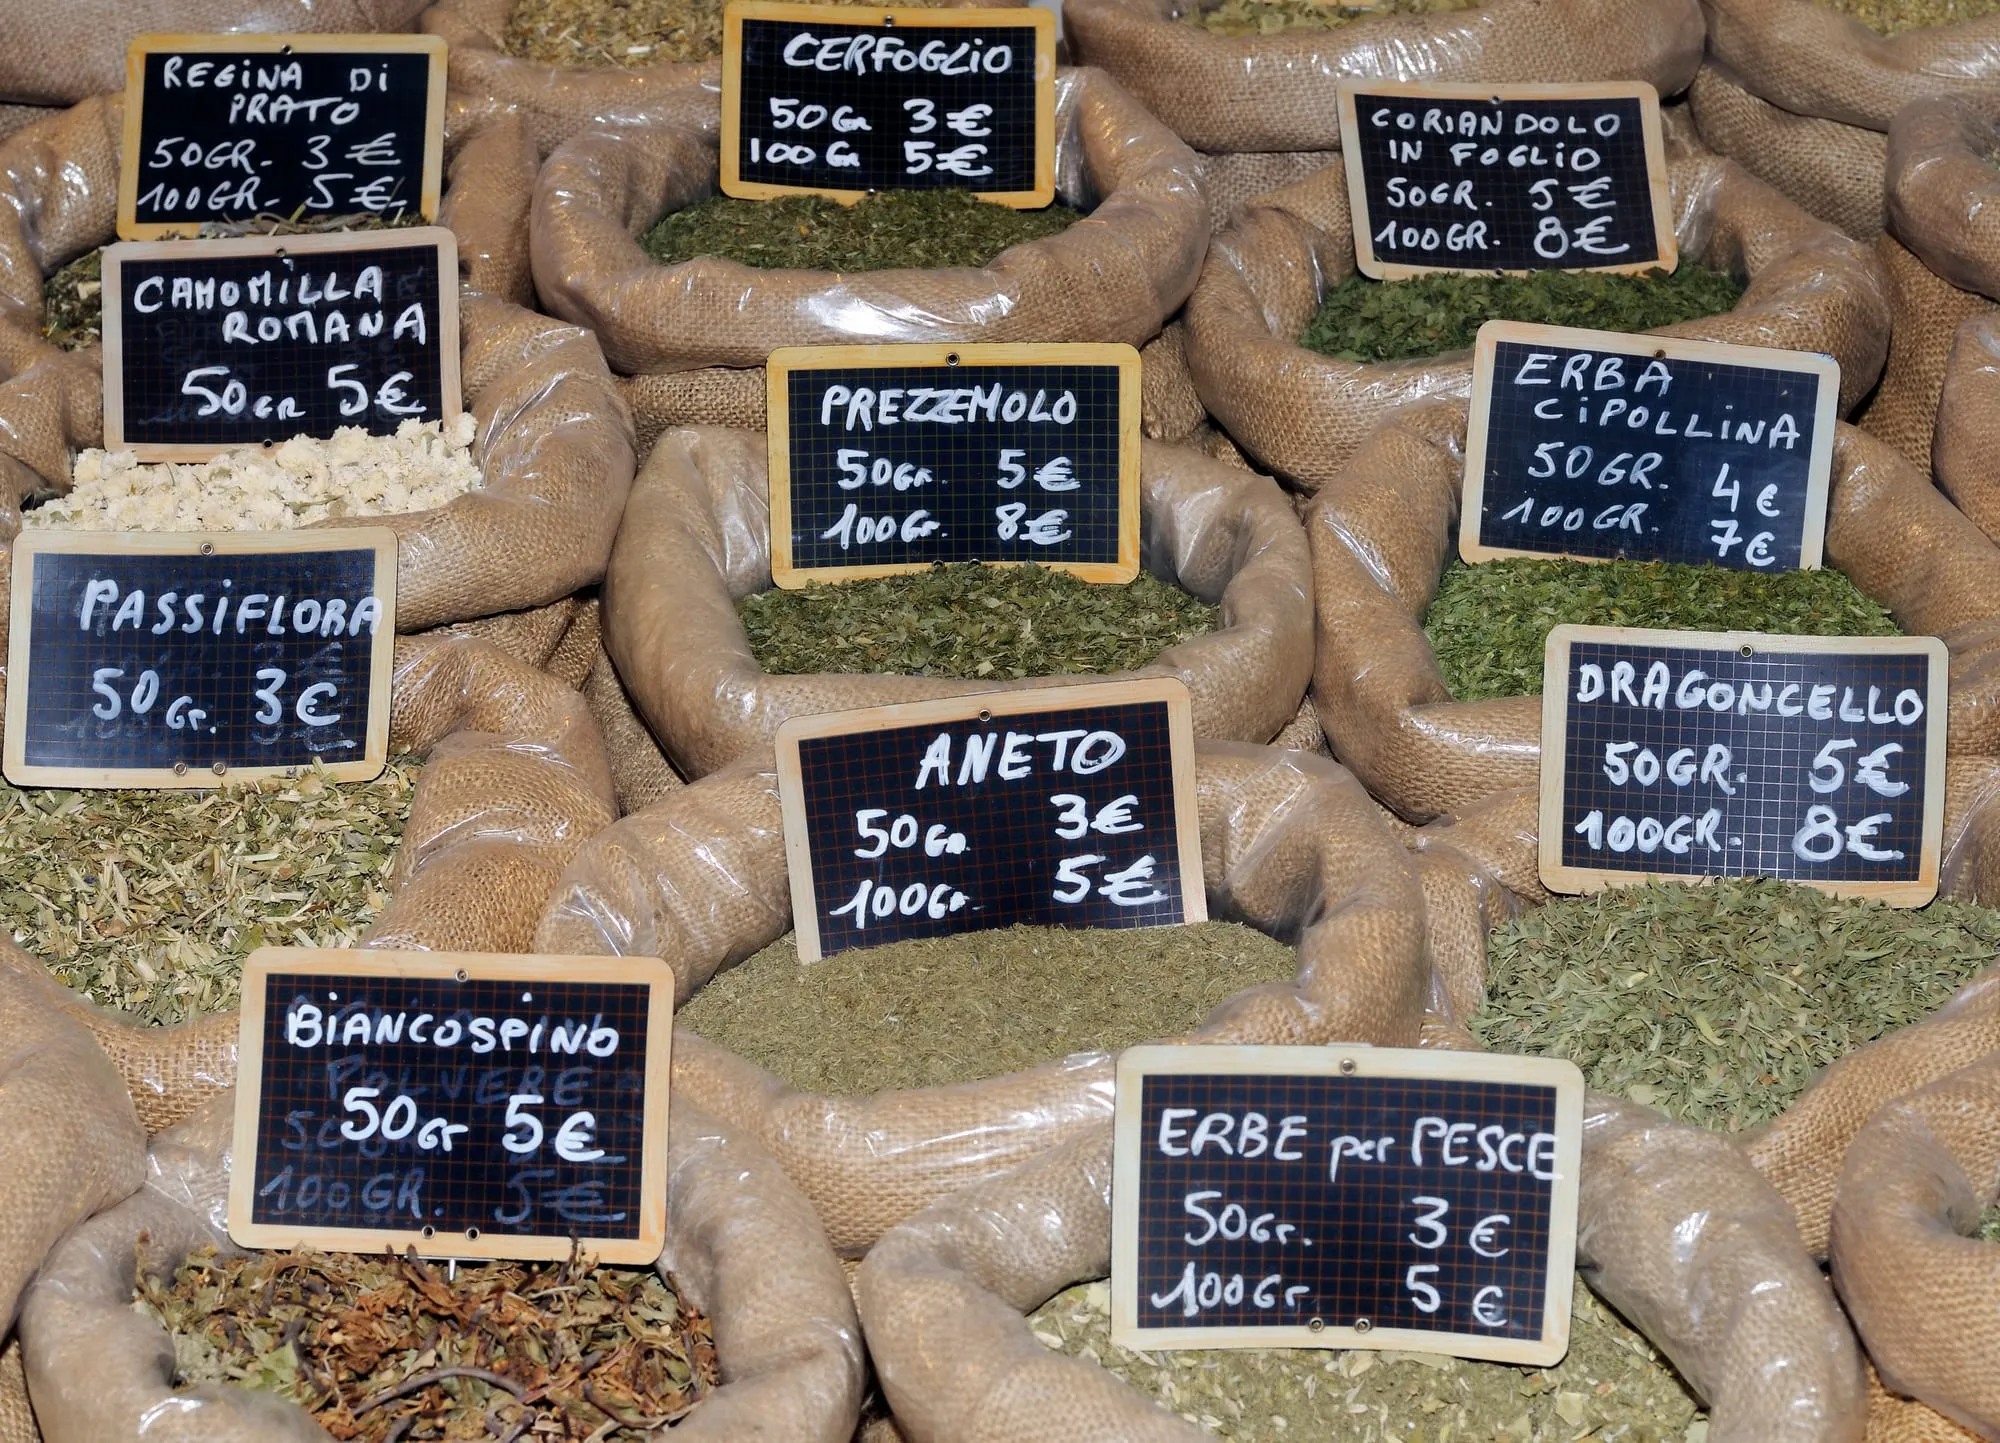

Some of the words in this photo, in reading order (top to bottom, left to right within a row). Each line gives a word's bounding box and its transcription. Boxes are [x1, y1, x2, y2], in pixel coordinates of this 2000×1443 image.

[784, 32, 1012, 76] CERFOGLIO
[229, 93, 360, 125] PRATO
[1389, 140, 1422, 163] IN
[1450, 142, 1601, 172] FOGLIO
[222, 302, 427, 346] ROMANA
[1514, 352, 1673, 397] ERBA
[79, 578, 383, 638] PASSIFLORA
[1576, 660, 1924, 726] DRAGONCELLO
[915, 730, 1127, 790] ANETO
[1158, 1108, 1308, 1161] ERBE
[1330, 1135, 1395, 1182] per
[1411, 1117, 1564, 1181] PESCE
